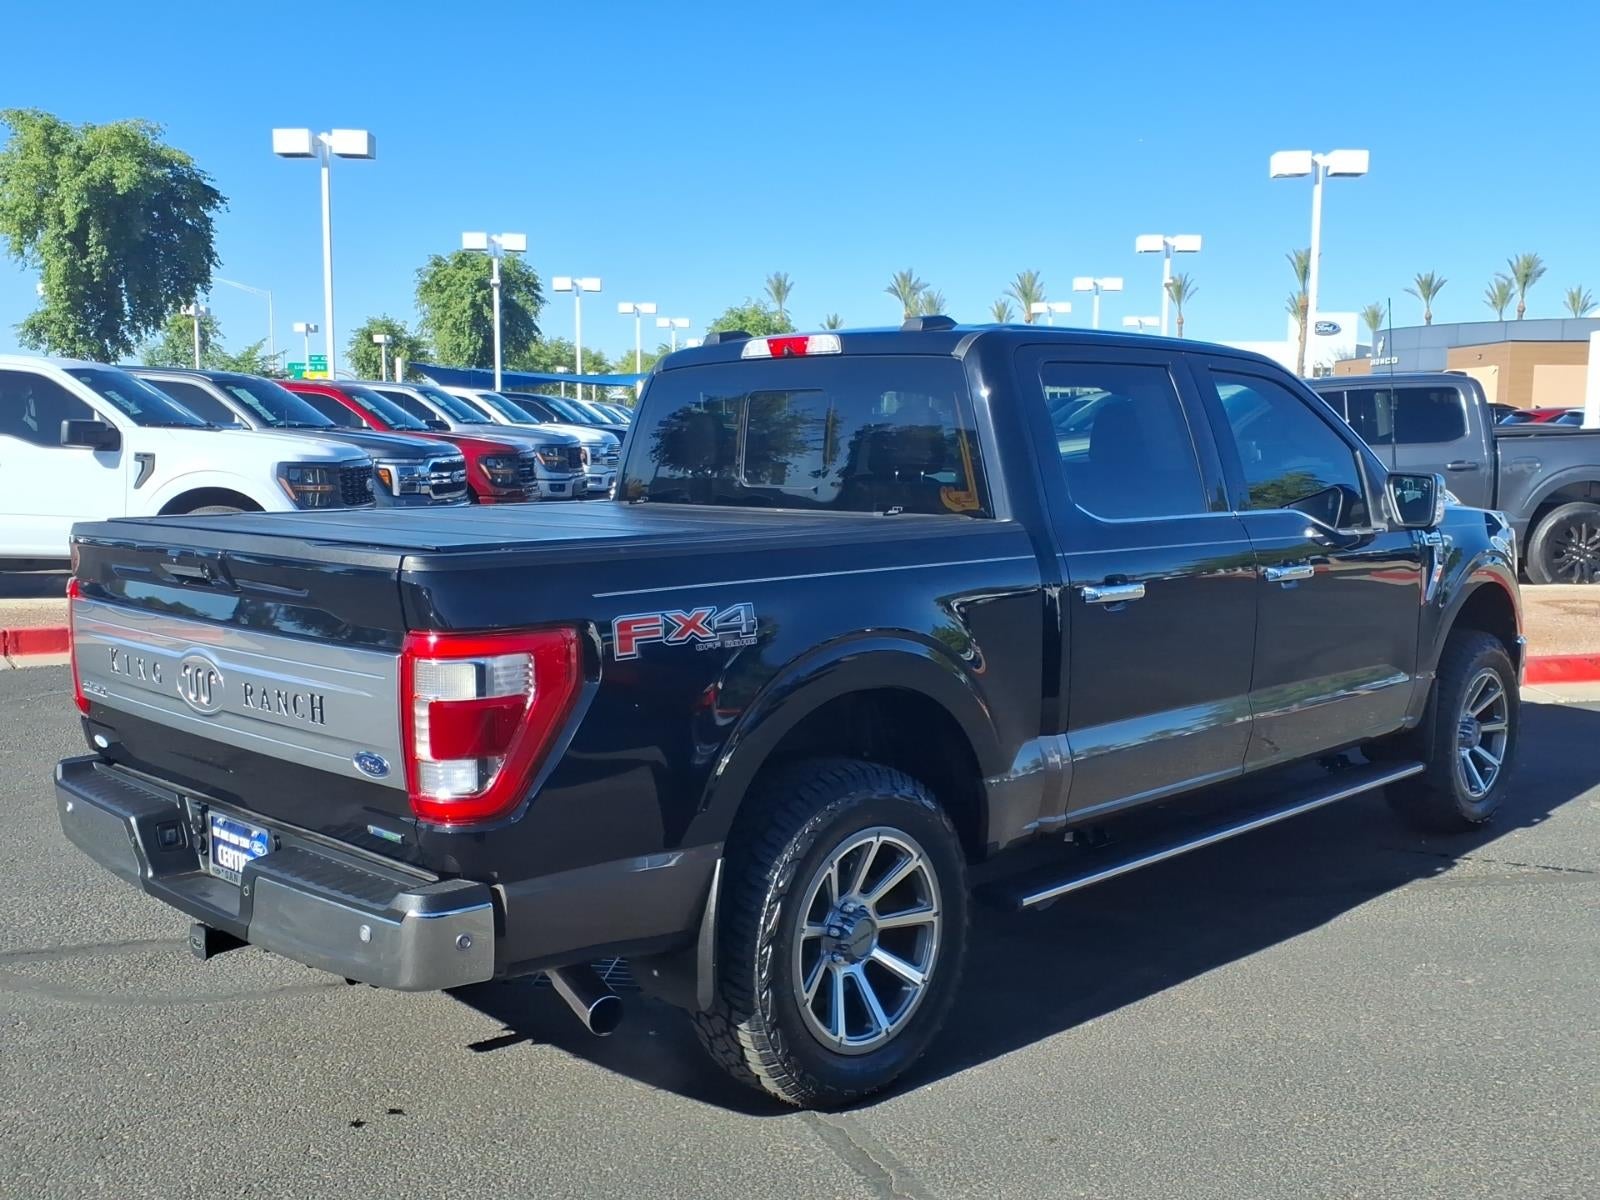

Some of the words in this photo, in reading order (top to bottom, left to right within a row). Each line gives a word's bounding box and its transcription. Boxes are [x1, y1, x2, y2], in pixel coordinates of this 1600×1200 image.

[612, 602, 758, 662] FX4
[108, 648, 163, 685] KING
[241, 682, 327, 726] RANCH
